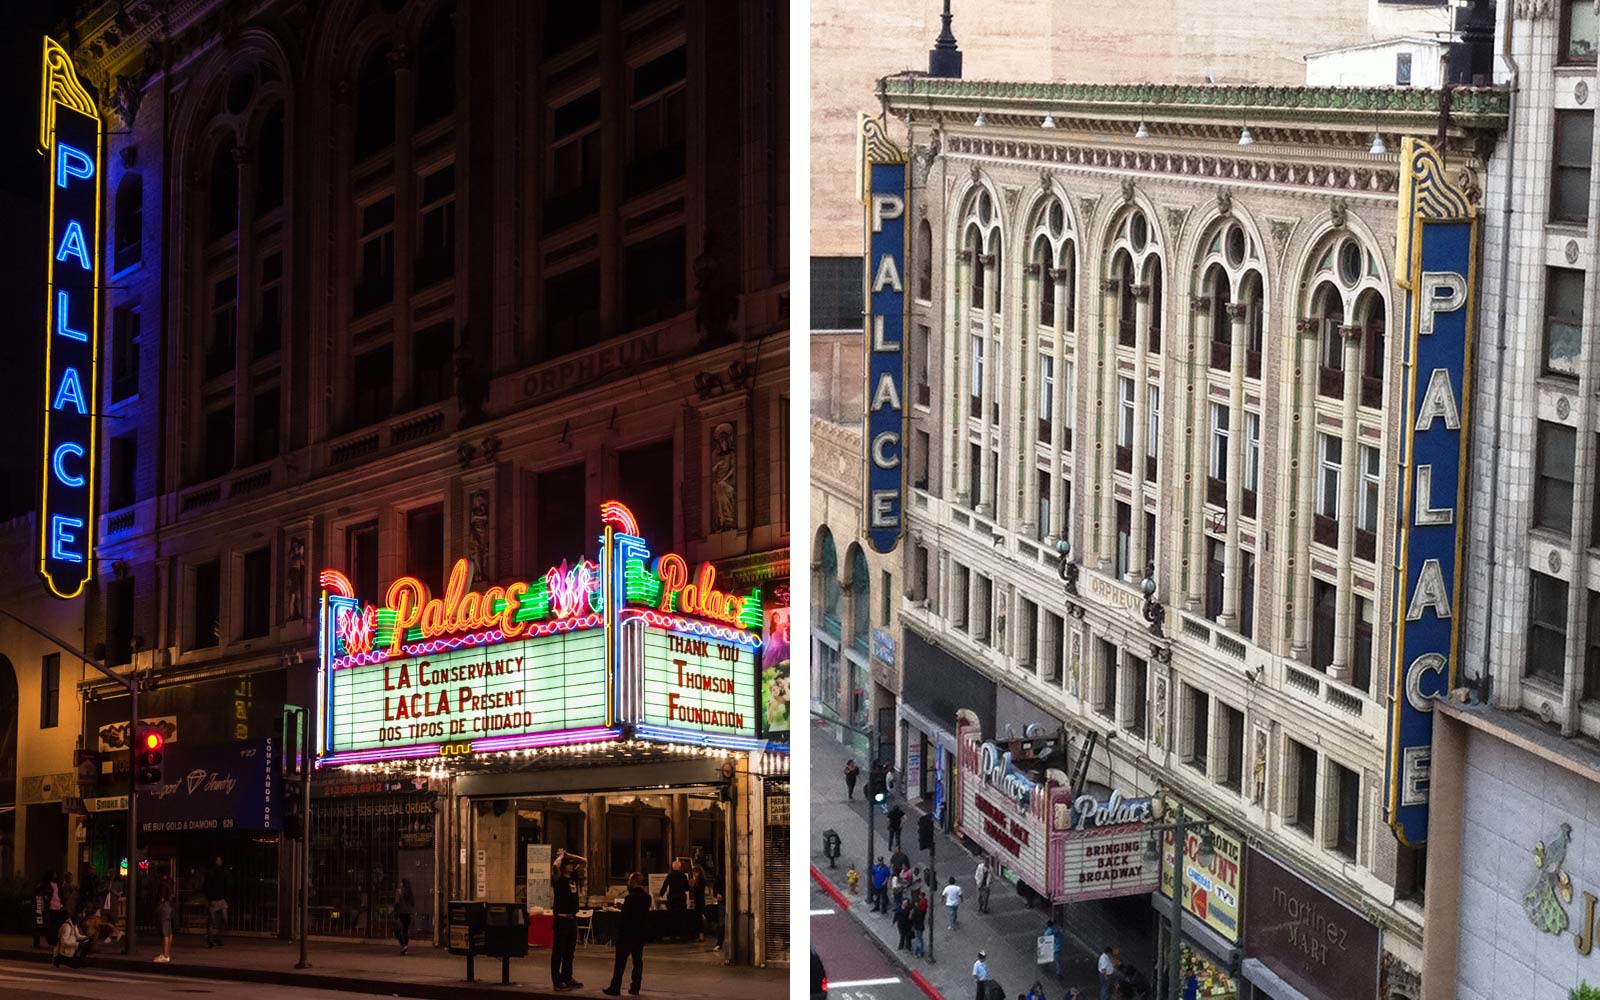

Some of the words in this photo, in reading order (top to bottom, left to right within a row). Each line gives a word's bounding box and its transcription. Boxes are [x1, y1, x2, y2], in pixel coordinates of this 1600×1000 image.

[51, 143, 95, 563] PALACE
[871, 194, 905, 528] PALACE
[1402, 271, 1467, 806] PALACE
[668, 634, 709, 658] THANK
[717, 643, 740, 662] YOU
[384, 663, 411, 691] LA
[384, 689, 451, 721] LACLA
[379, 726, 402, 742] DOS
[408, 721, 444, 739] TIPOS
[450, 718, 466, 735] DE
[473, 711, 532, 733] CUIDADO
[143, 823, 153, 831] WE
[166, 820, 181, 831] GOLD
[189, 819, 217, 830] DIAMOND
[1086, 841, 1140, 857] BRINGING
[1097, 857, 1129, 869] BACK
[1078, 866, 1143, 884] BROADWAY
